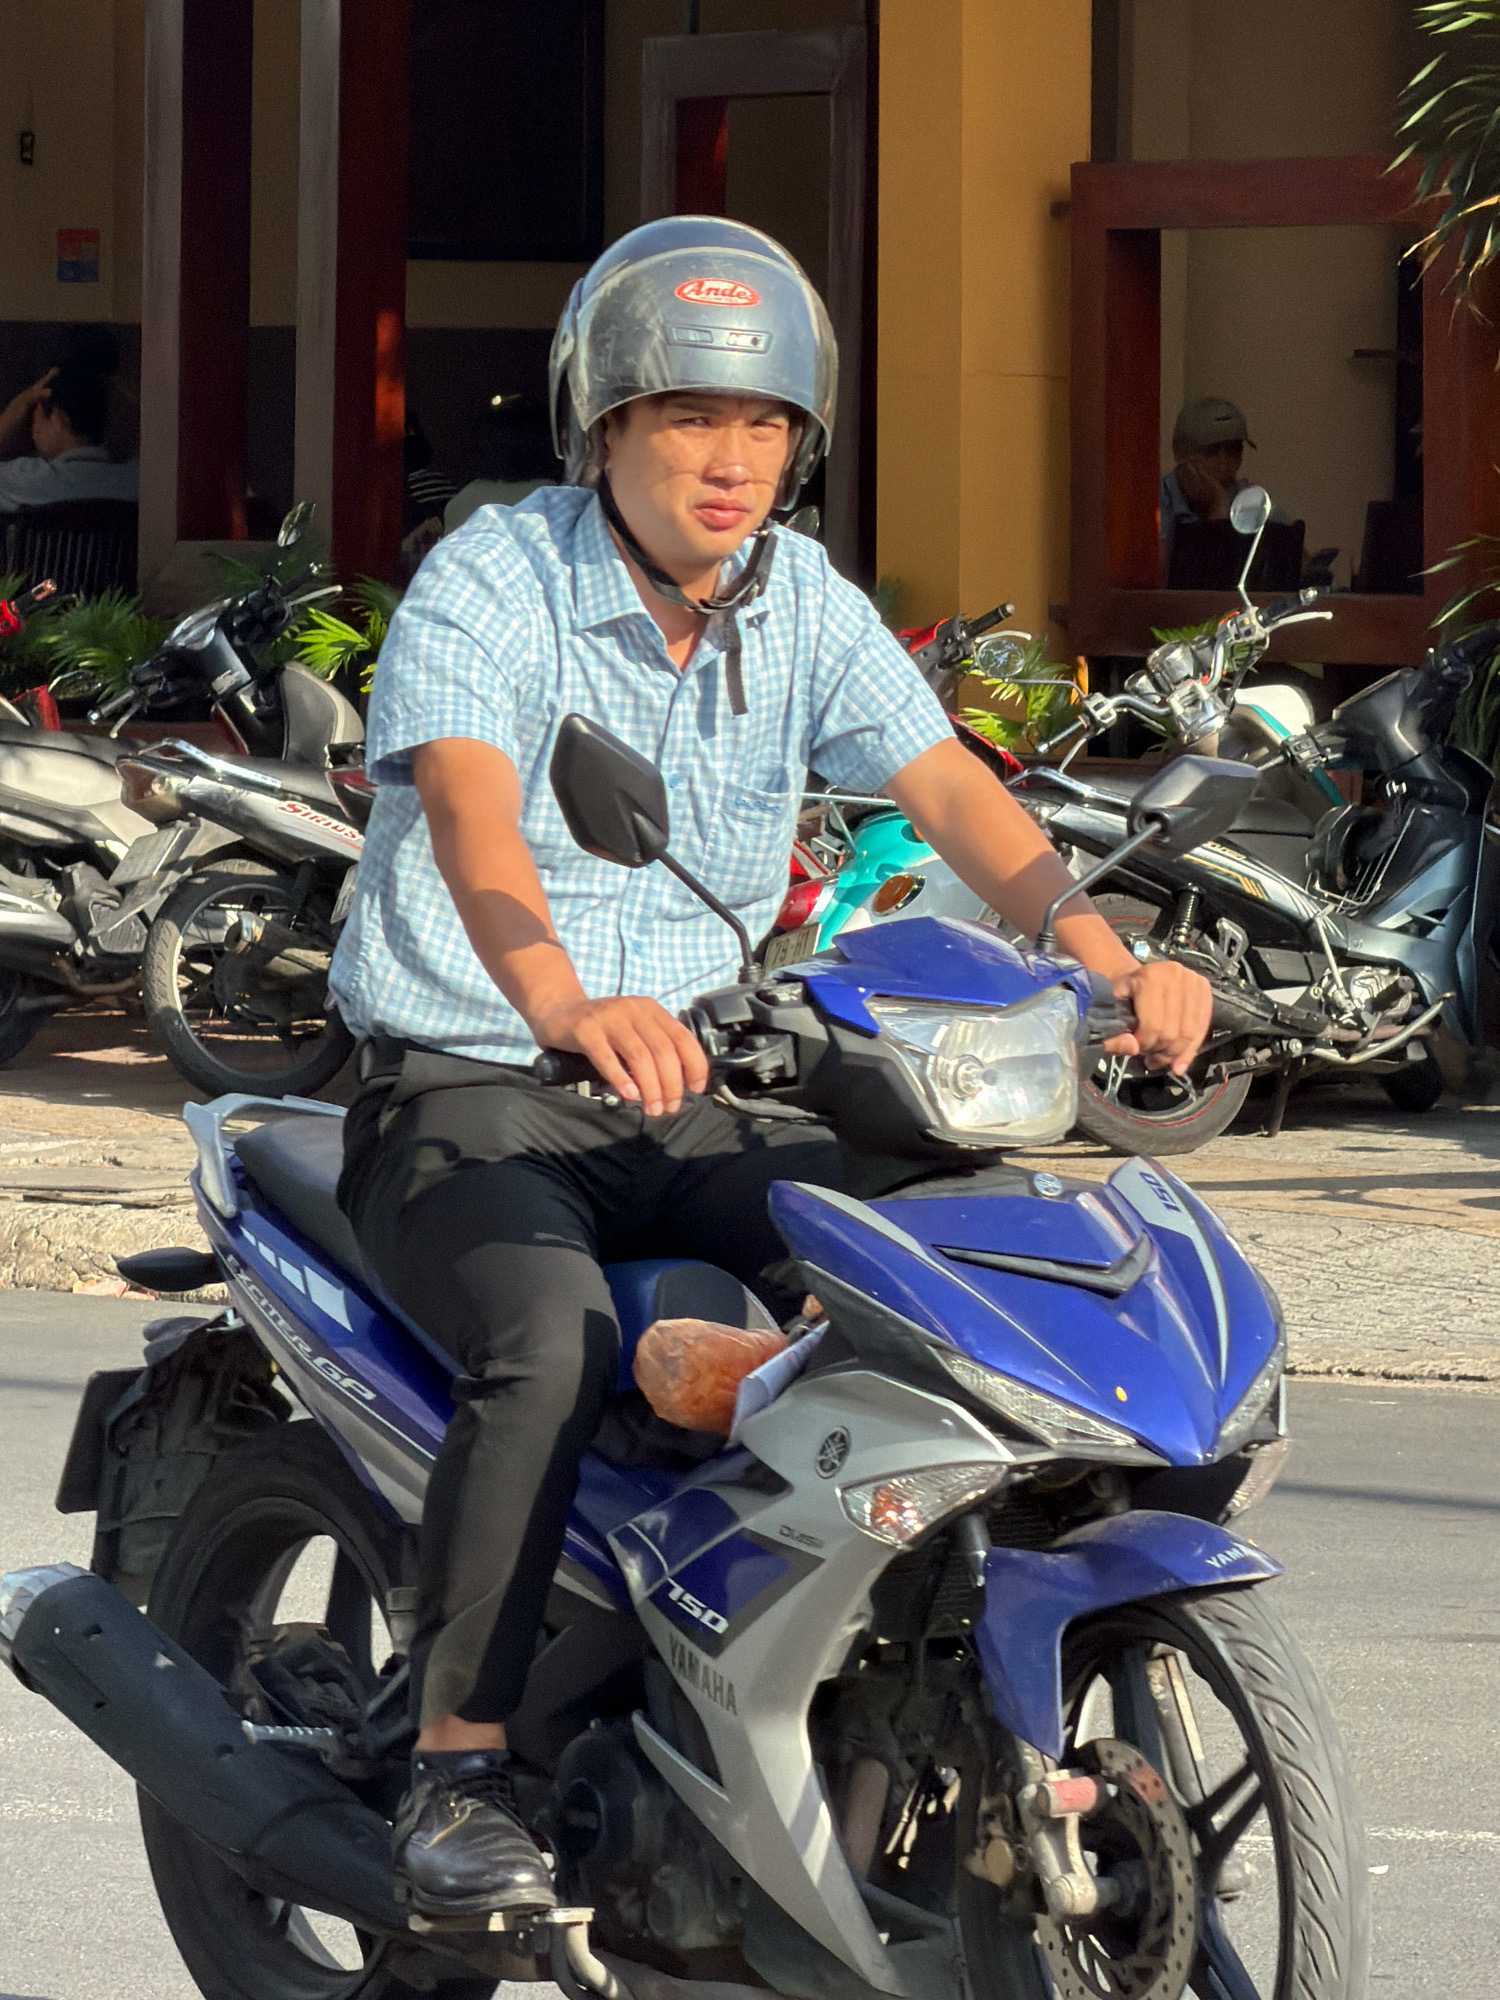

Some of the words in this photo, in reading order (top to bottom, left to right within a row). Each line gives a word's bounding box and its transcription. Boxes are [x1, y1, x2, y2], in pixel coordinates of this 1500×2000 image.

[1139, 1172, 1182, 1213] 150
[226, 1254, 313, 1358] EXCITER
[312, 1356, 377, 1400] GP
[667, 1577, 729, 1634] 150
[669, 1631, 738, 1717] YAMAHA
